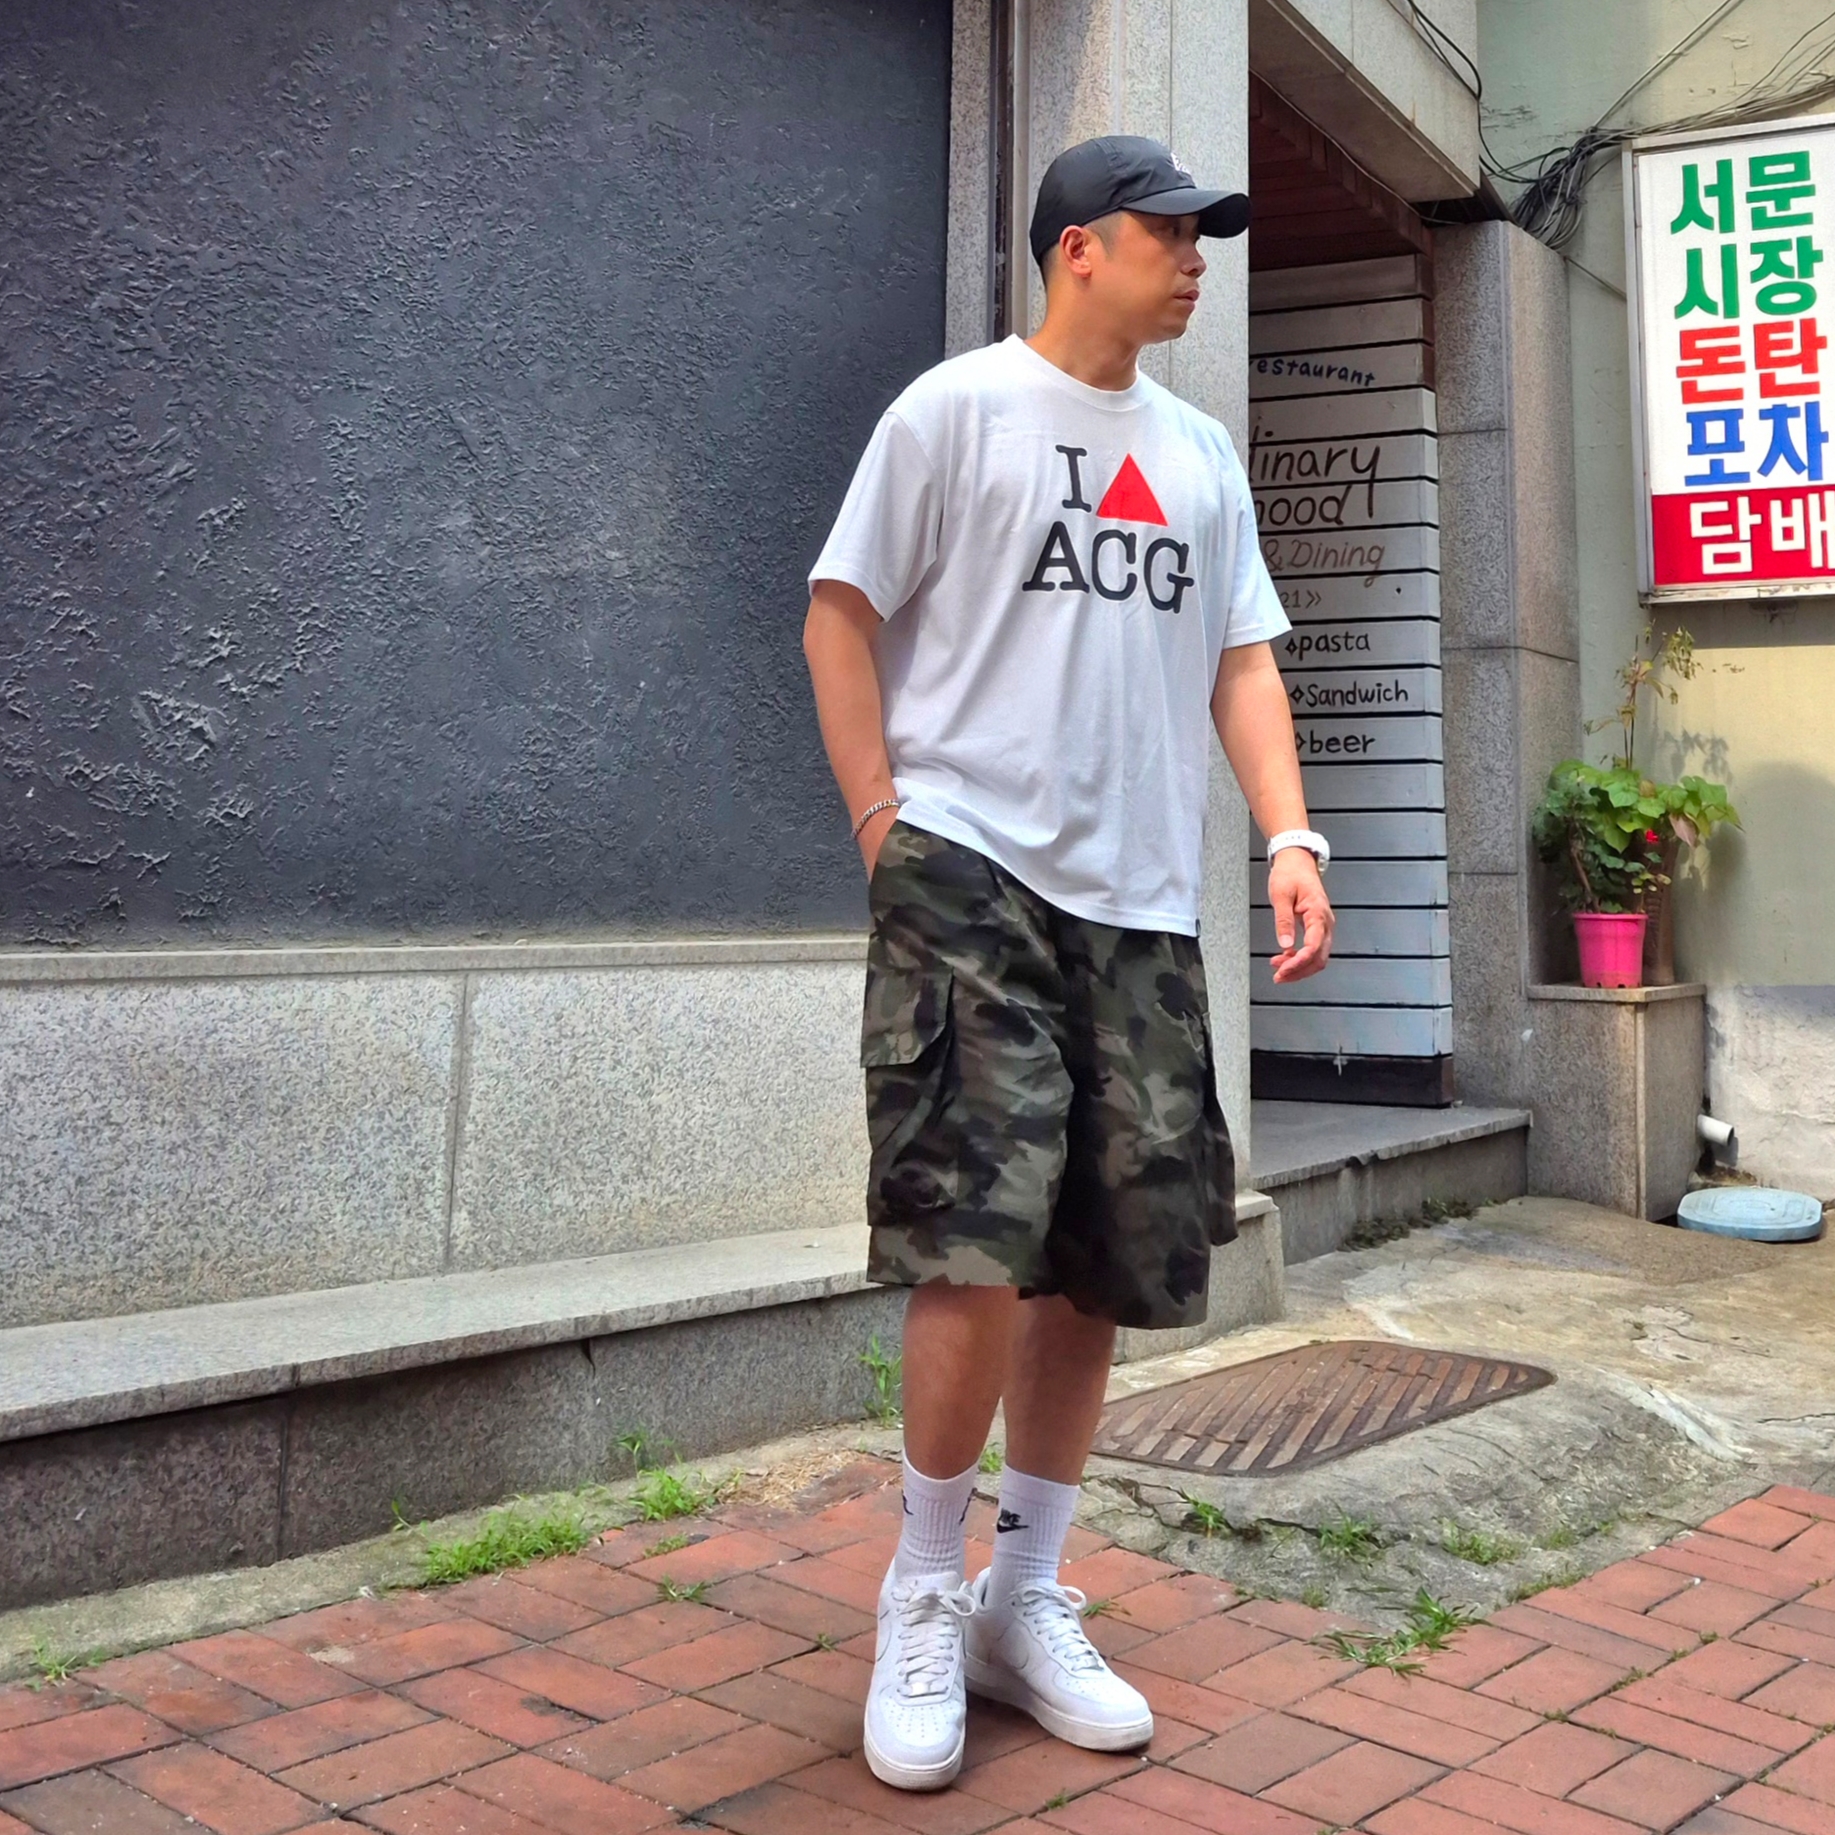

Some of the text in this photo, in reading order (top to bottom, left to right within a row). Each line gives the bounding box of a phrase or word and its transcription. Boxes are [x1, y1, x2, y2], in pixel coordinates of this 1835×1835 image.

[1670, 151, 1816, 235] 서문
[1674, 235, 1823, 319] 시장
[1249, 358, 1376, 387] estaurant
[1676, 317, 1827, 404] 돈탄
[1055, 444, 1092, 513] I
[1684, 401, 1829, 486] 포차
[1022, 521, 1194, 614] ACG
[1264, 538, 1386, 588] & Dining
[1689, 490, 1835, 575] 담배
[1298, 630, 1371, 660] pasta
[1306, 679, 1409, 708] Sandwich
[1309, 730, 1375, 754] beer
